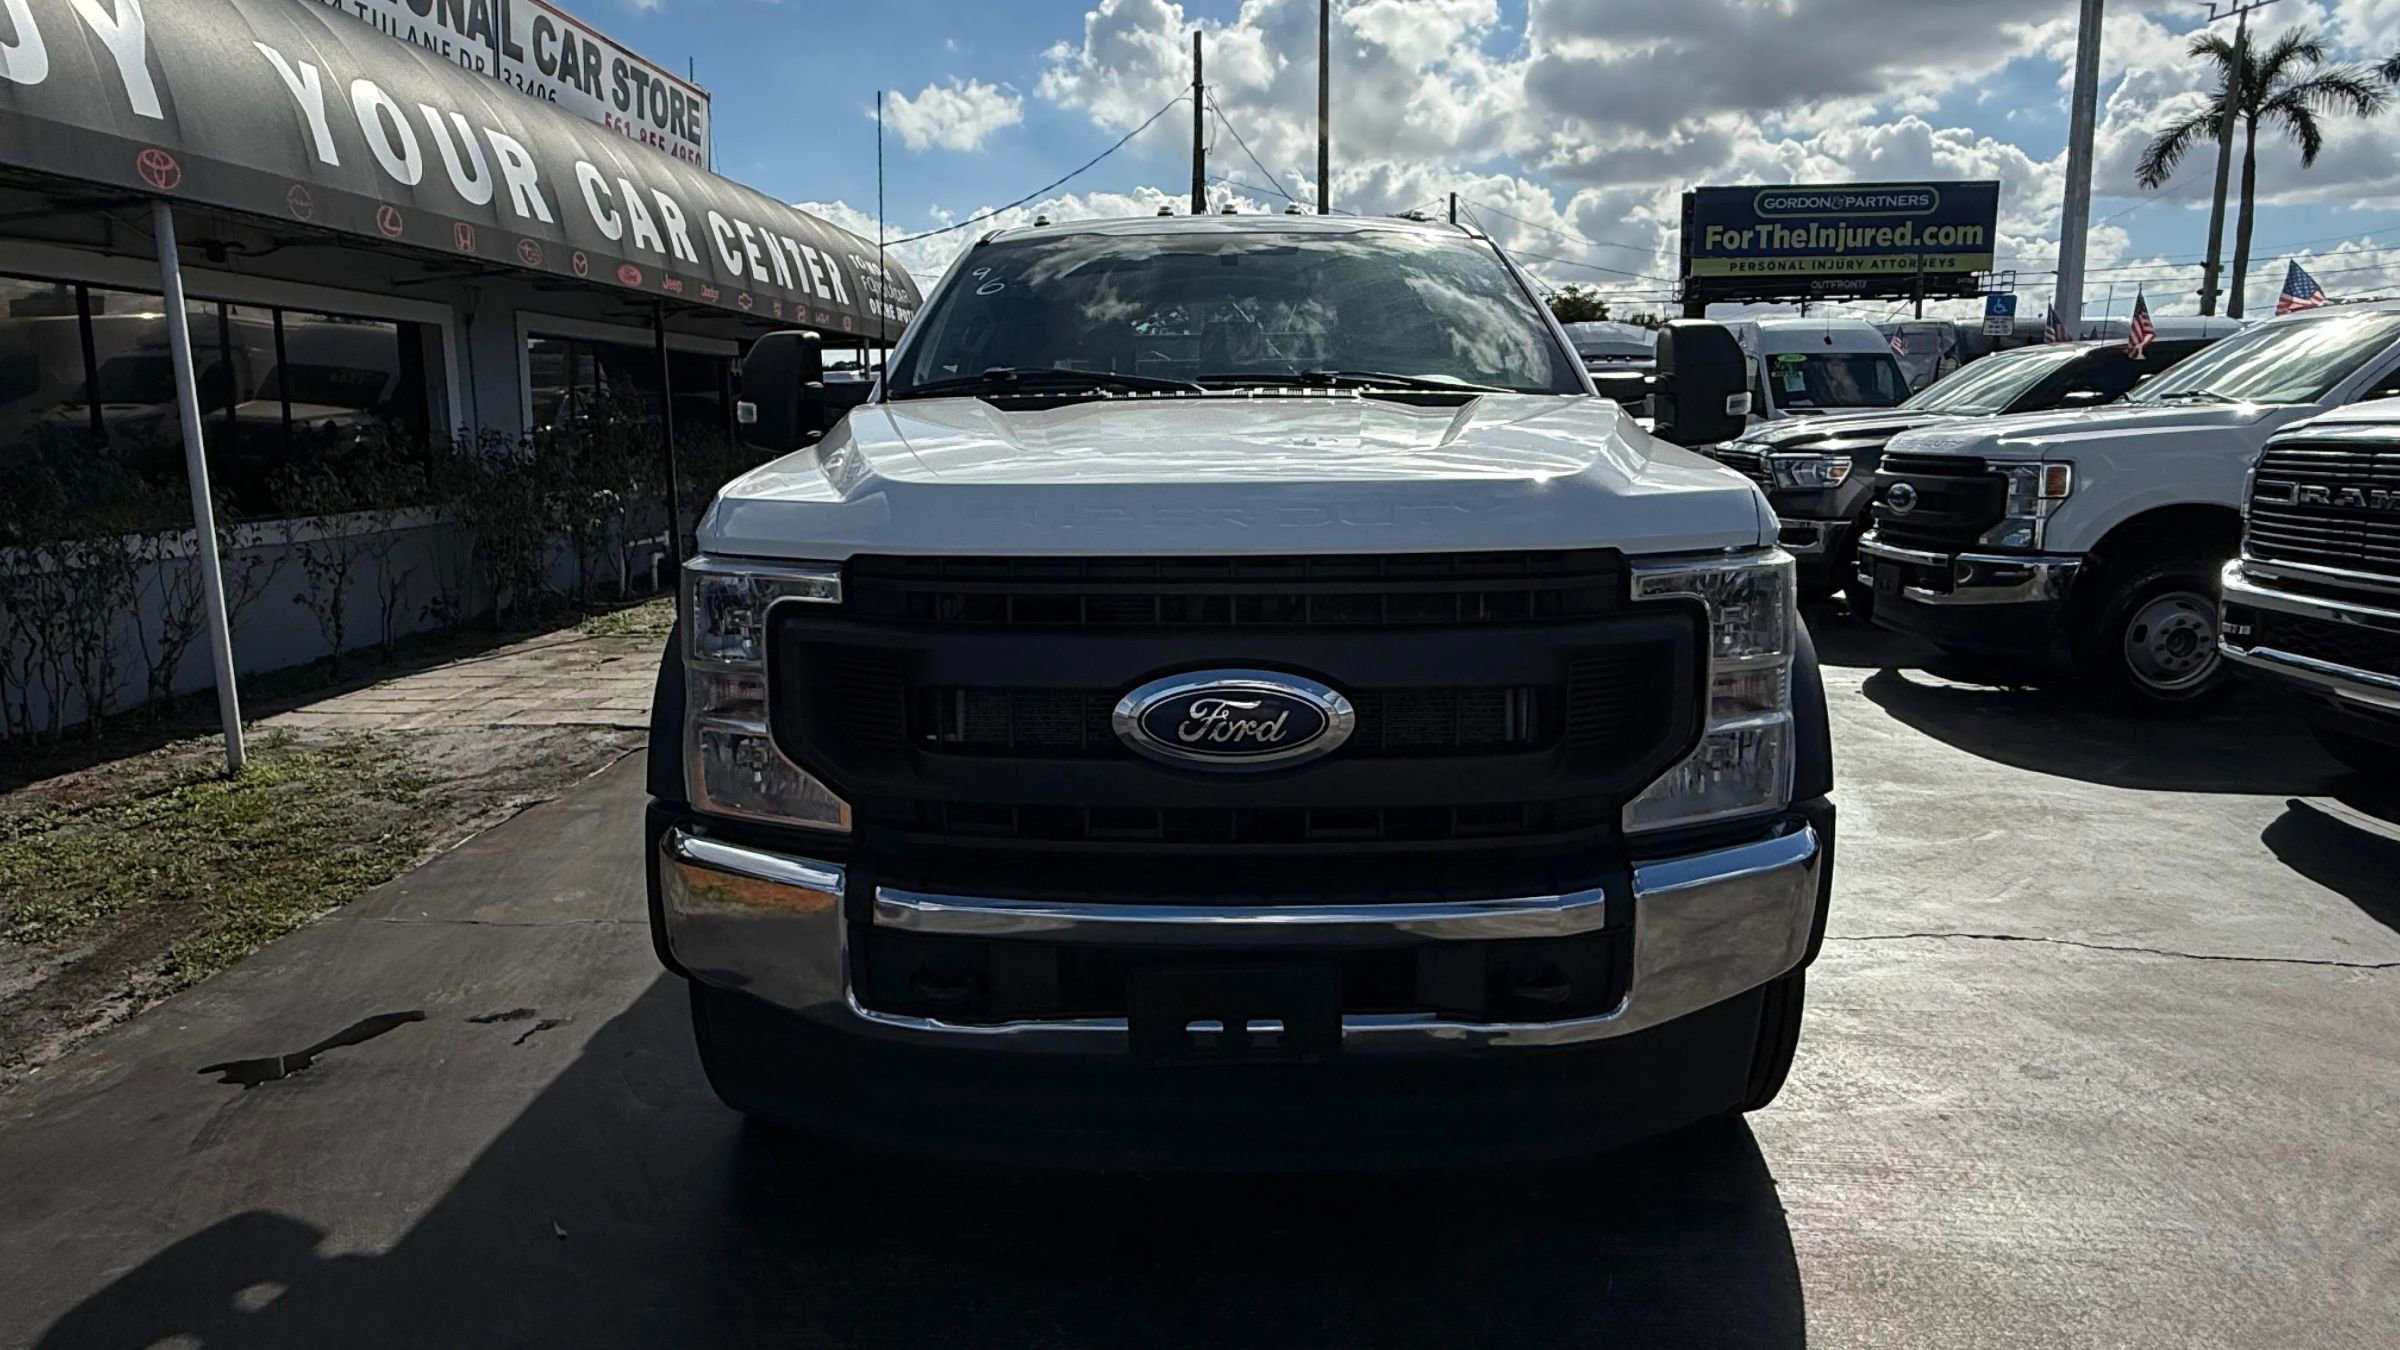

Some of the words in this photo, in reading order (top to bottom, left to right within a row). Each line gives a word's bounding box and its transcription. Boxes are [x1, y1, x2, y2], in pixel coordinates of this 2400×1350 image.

[533, 14, 604, 102] CAR
[612, 57, 702, 147] STORE
[253, 41, 554, 224] YOUR
[575, 160, 699, 264] CAR
[708, 210, 850, 306] CENTER
[1764, 196, 1831, 210] GORDON
[1845, 194, 1930, 208] PARTNERS
[1705, 221, 1984, 252] ForTheInjured.com
[1729, 259, 1806, 272] PERSONAL
[1811, 258, 1864, 271] INJURY
[1178, 698, 1290, 742] Ford
